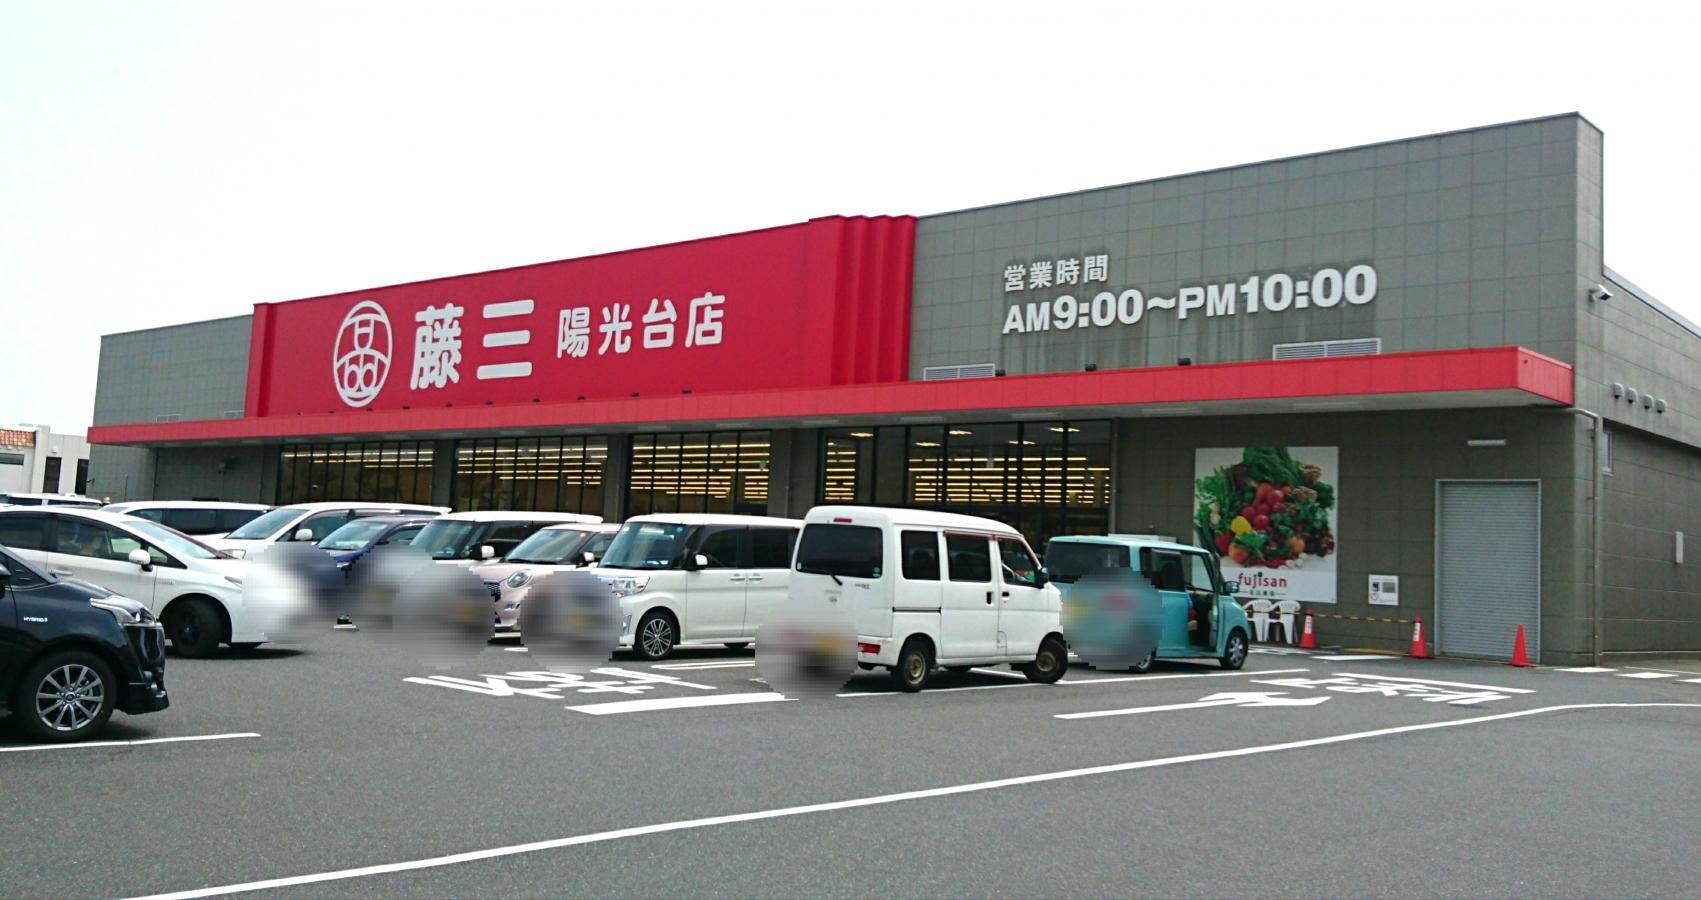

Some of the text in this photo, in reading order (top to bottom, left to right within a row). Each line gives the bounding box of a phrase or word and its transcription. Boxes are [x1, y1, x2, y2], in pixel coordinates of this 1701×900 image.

[1003, 253, 1109, 293] 営業時間
[409, 291, 726, 391] 藤三 陽光台店
[1237, 571, 1288, 589] fujisan
